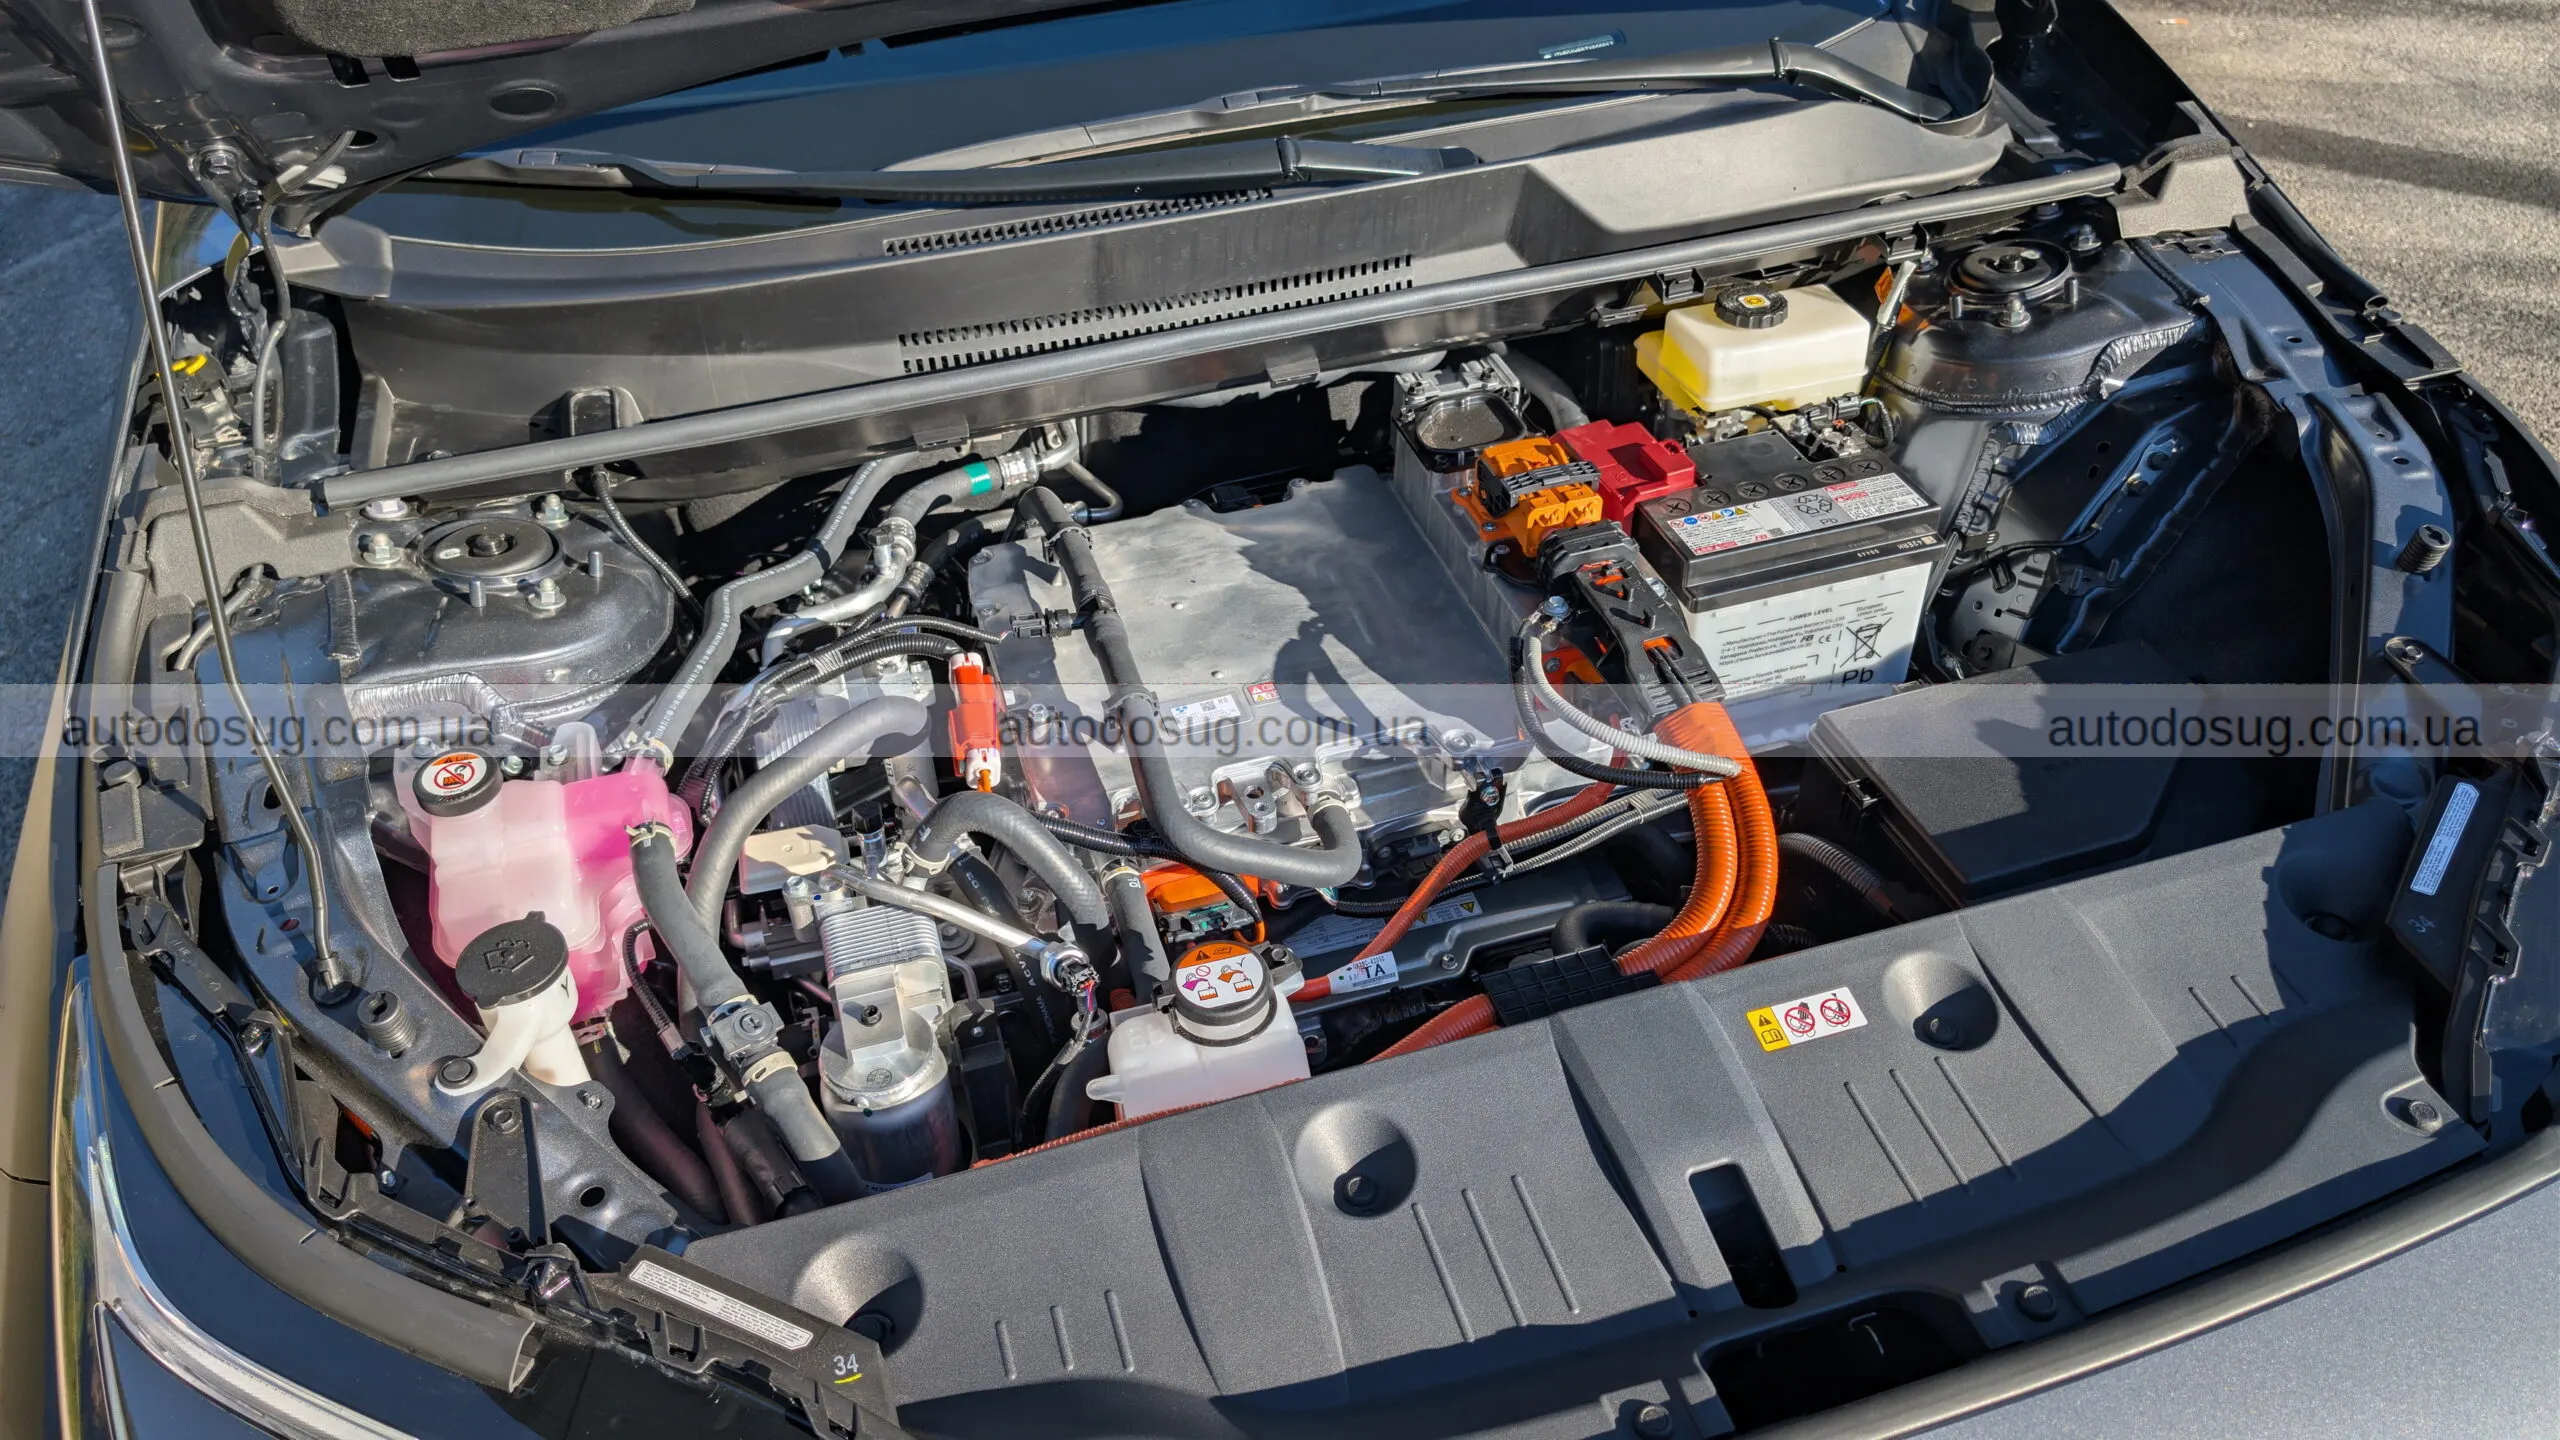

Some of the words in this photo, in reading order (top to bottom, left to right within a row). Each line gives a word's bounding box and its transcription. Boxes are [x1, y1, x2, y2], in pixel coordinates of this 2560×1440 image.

[1820, 518, 1838, 526] Pb
[1789, 612, 1812, 621] LOWER
[1813, 608, 1833, 616] LEVEL
[1818, 634, 1832, 644] CE
[1841, 668, 1874, 688] Pb
[2408, 915, 2436, 933] 34
[832, 1353, 860, 1376] 34
